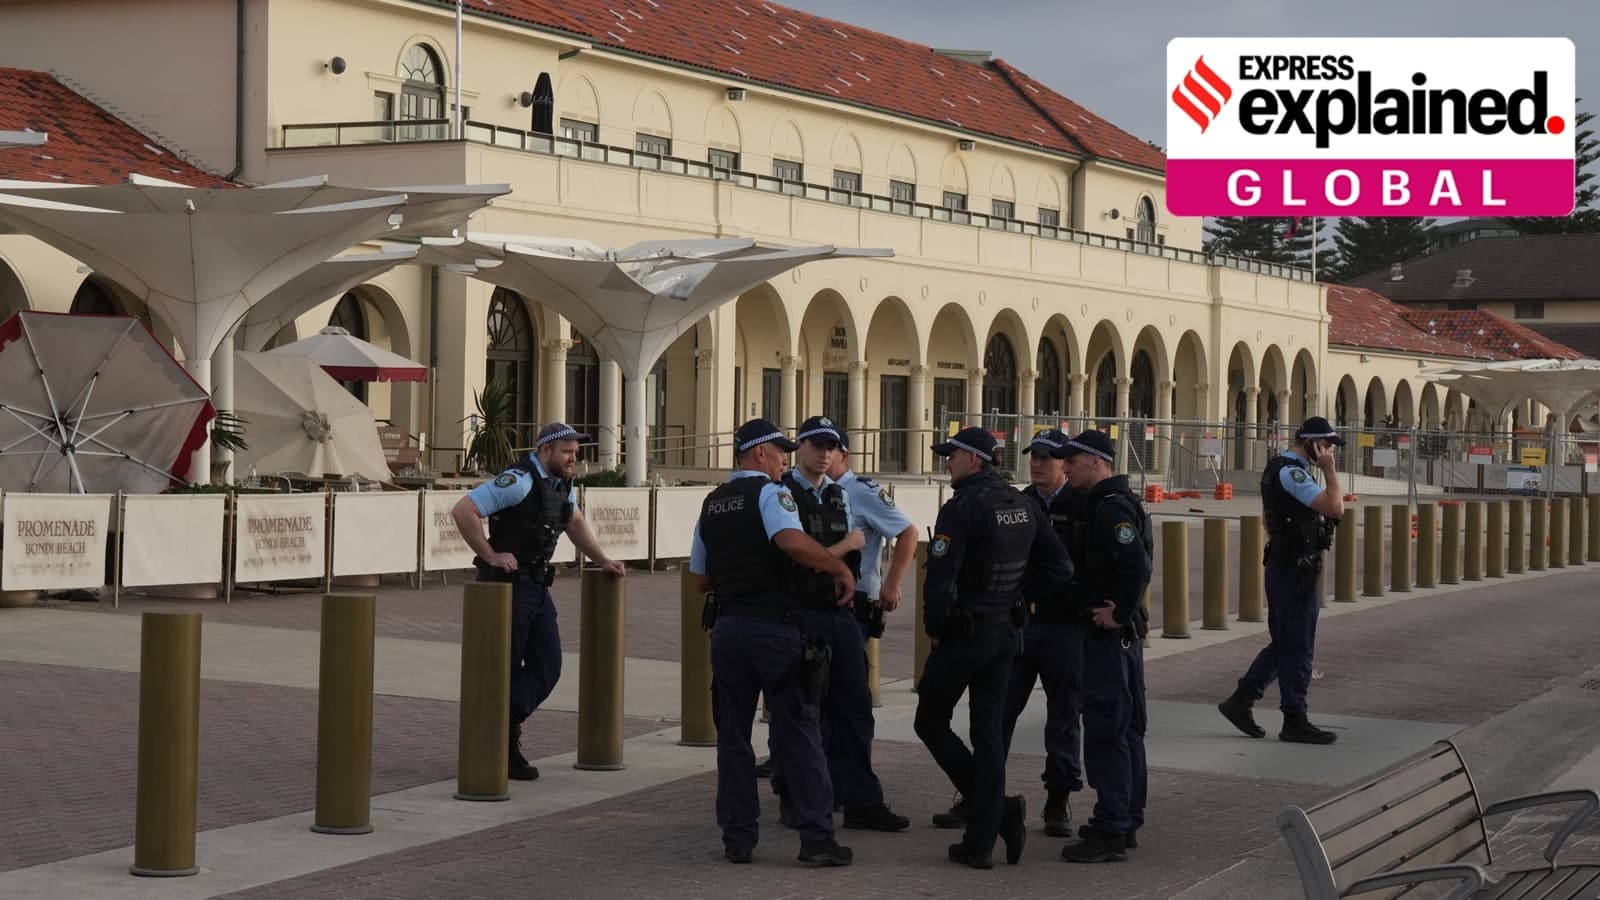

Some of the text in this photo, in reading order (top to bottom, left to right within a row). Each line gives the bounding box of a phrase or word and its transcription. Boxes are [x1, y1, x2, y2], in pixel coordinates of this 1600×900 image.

[592, 507, 640, 521] PROMENADE
[707, 499, 744, 515] POLICE
[248, 516, 313, 533] PROMENADE
[997, 512, 1029, 525] POLICE
[17, 520, 95, 537] PROMENADE
[25, 542, 86, 555] BONDI BEACH
[280, 536, 305, 548] BEACH
